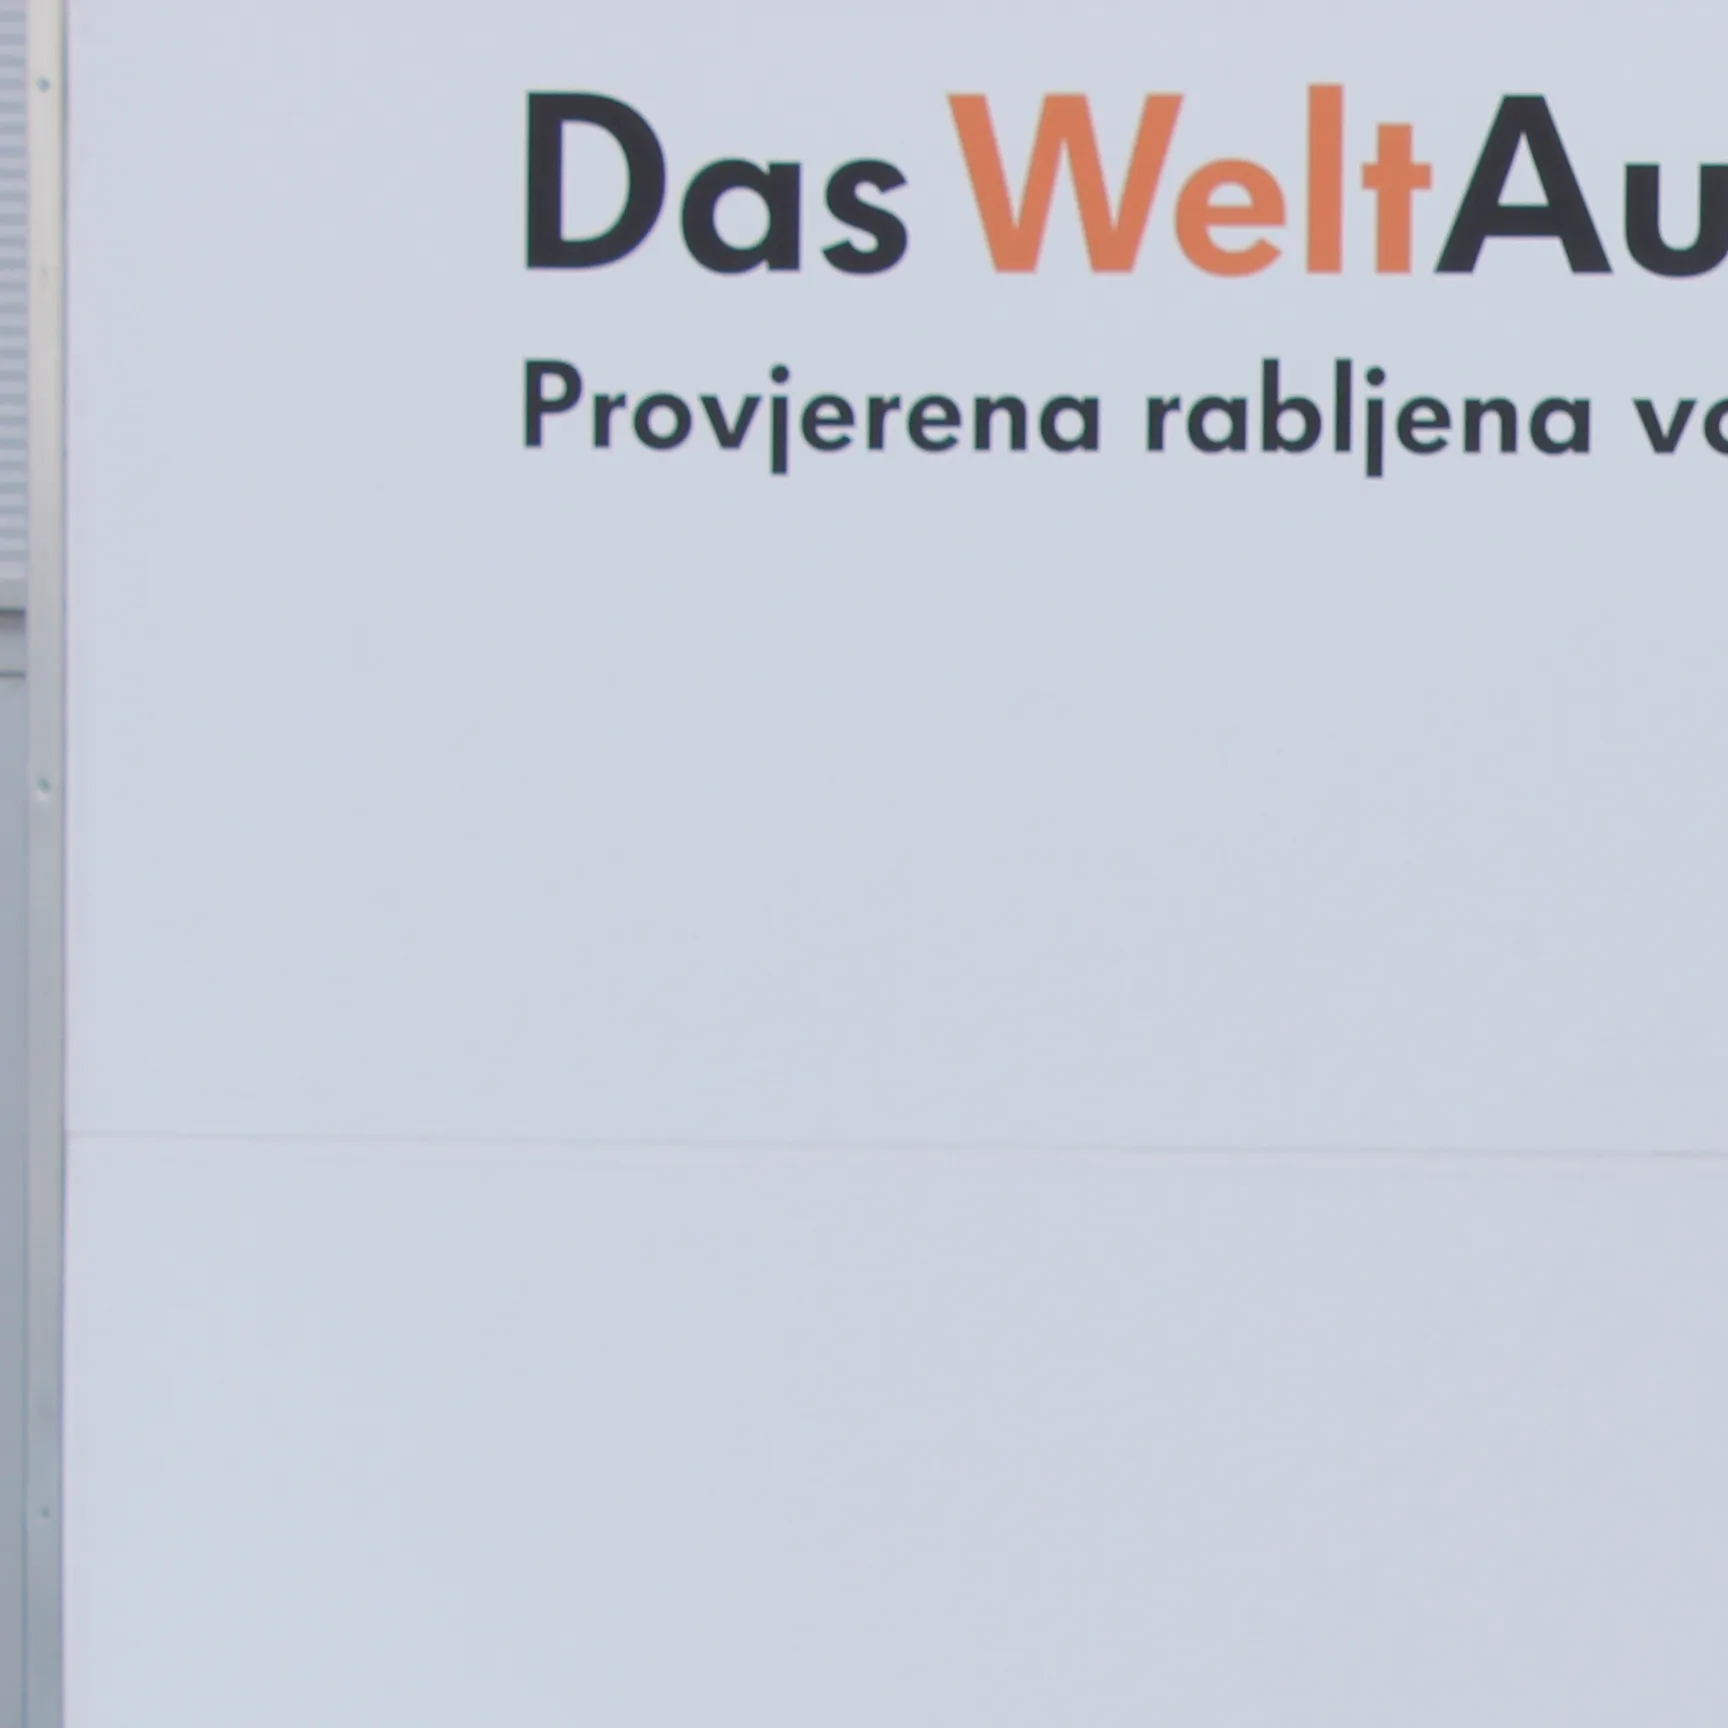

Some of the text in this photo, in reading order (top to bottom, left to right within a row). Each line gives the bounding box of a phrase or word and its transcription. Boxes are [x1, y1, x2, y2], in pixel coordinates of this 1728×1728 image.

[524, 90, 908, 276] Das
[524, 358, 1100, 475] Provjerena
[1146, 357, 1591, 478] rabljena
